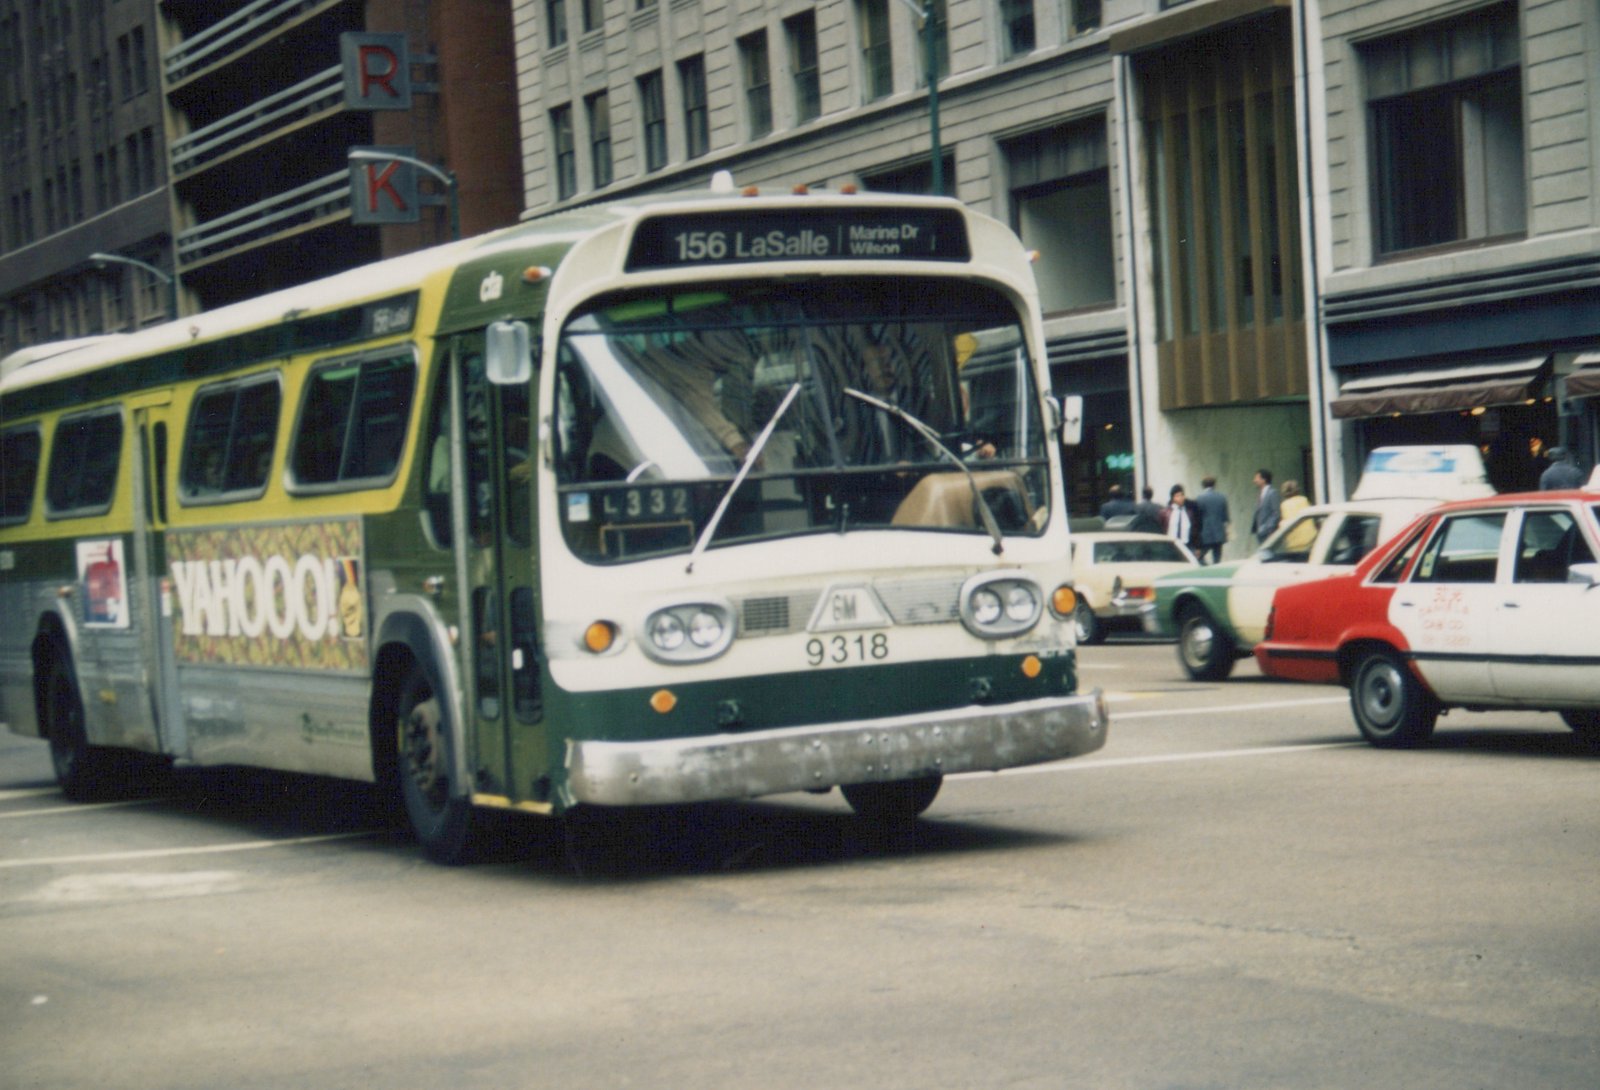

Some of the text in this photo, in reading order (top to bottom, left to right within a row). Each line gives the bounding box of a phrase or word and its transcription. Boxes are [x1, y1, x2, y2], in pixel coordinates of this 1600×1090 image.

[358, 44, 399, 98] R
[367, 160, 408, 213] K
[675, 229, 830, 261] 156 LaSalle
[849, 223, 920, 241] Marine Dr
[849, 241, 901, 255] Wilson
[171, 553, 339, 641] YAHOOO!
[806, 633, 889, 667] 9318
